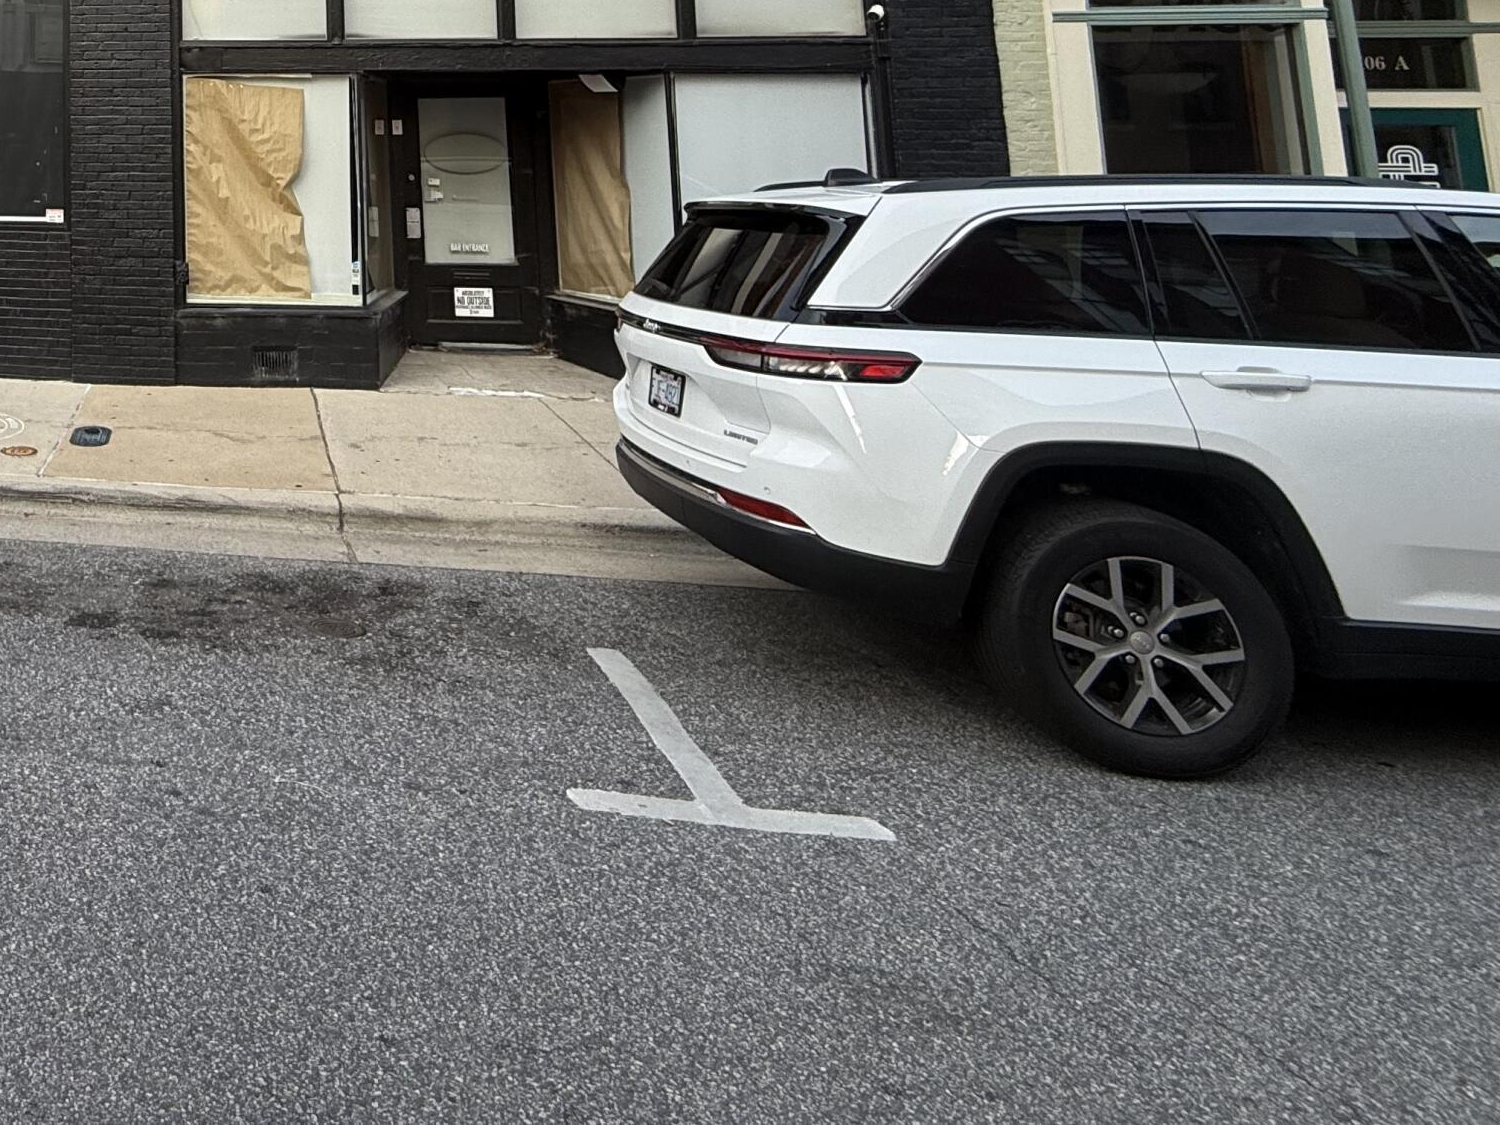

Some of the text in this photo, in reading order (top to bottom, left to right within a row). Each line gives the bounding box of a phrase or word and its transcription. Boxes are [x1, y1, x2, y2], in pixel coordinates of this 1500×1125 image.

[1363, 56, 1410, 70] 06 A
[457, 297, 490, 305] NO OUTSIDE
[723, 429, 758, 445] LIMITED
